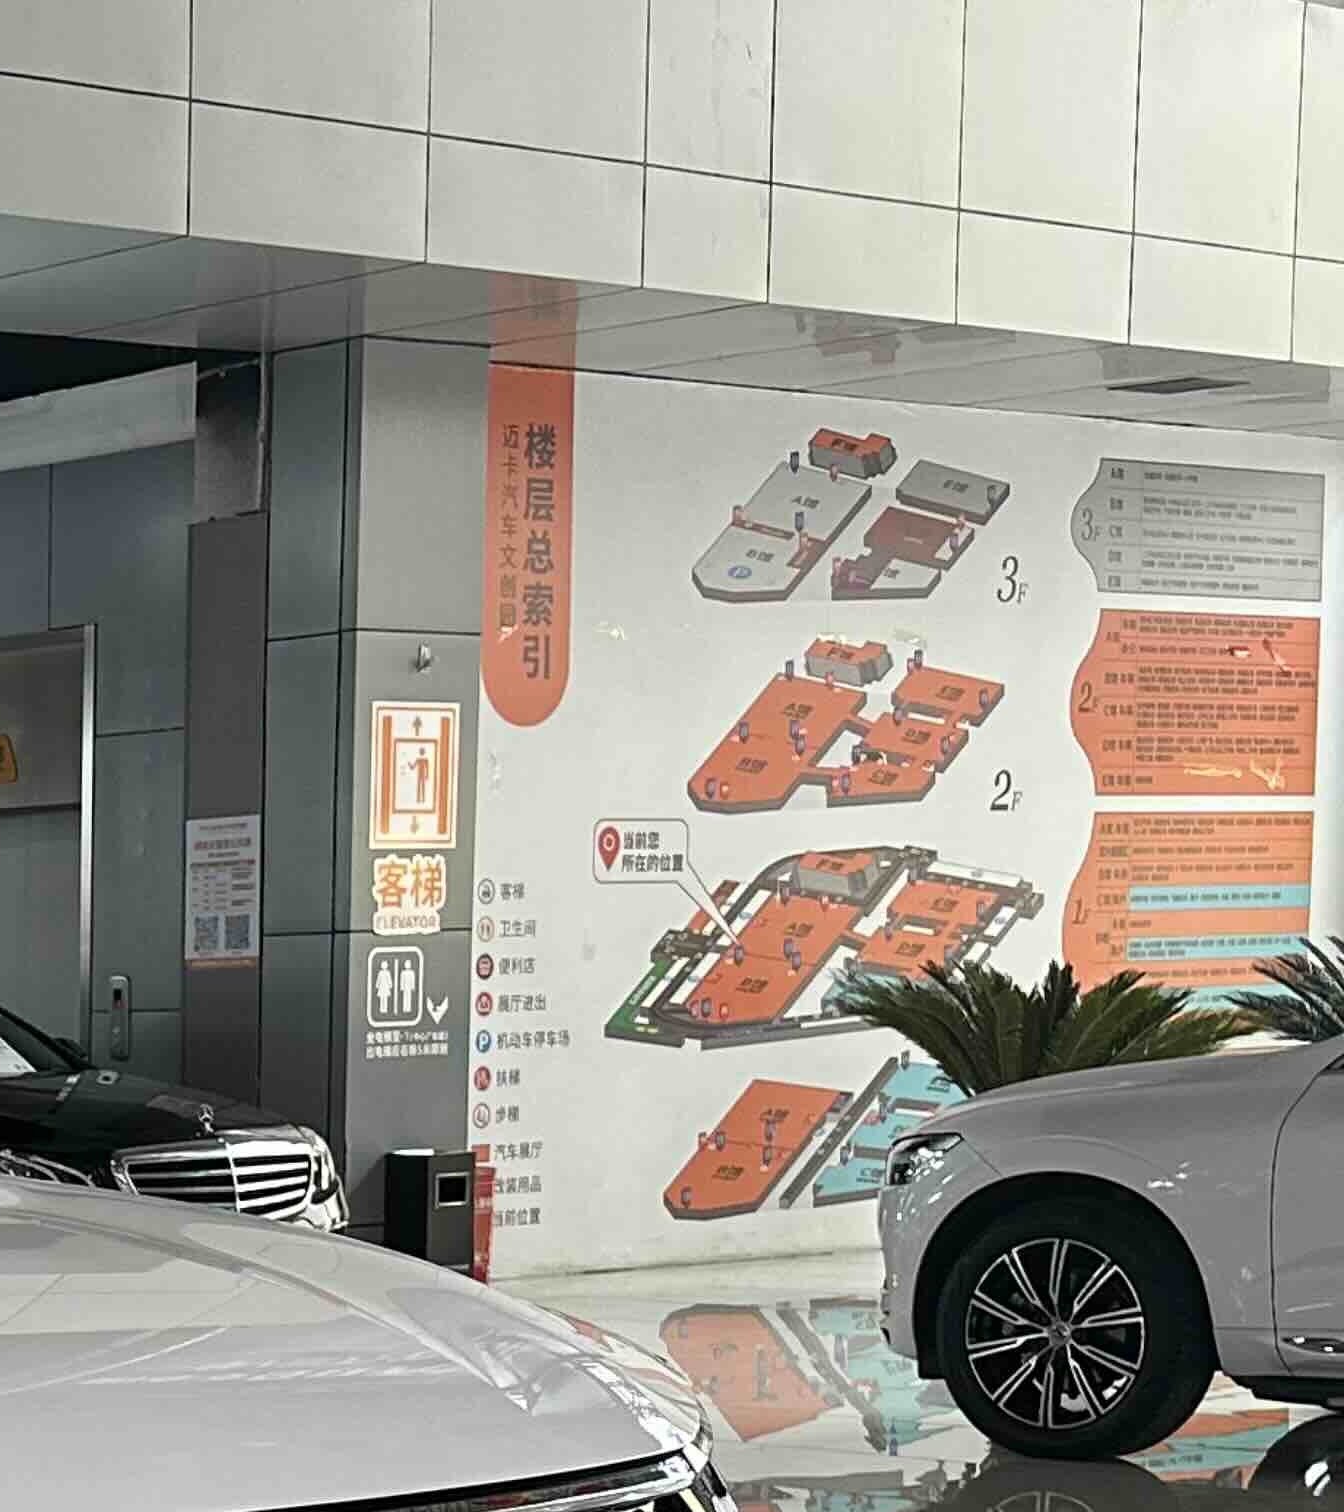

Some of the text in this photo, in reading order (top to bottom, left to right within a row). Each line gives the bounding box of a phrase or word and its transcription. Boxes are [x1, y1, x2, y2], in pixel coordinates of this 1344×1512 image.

[523, 422, 557, 680] 楼层总索引
[997, 556, 1029, 603] 3F
[990, 769, 1023, 812] 2F
[623, 831, 660, 851] 当前您
[621, 853, 684, 874] 所在的位置
[375, 860, 444, 909] 客梯
[500, 883, 525, 900] 客梯
[376, 914, 437, 930] ELEVATOR
[499, 920, 537, 938] 卫生间
[498, 957, 535, 975] 便利店
[496, 1029, 571, 1049] 机动车停车场
[494, 1141, 543, 1161] 汽车展厅
